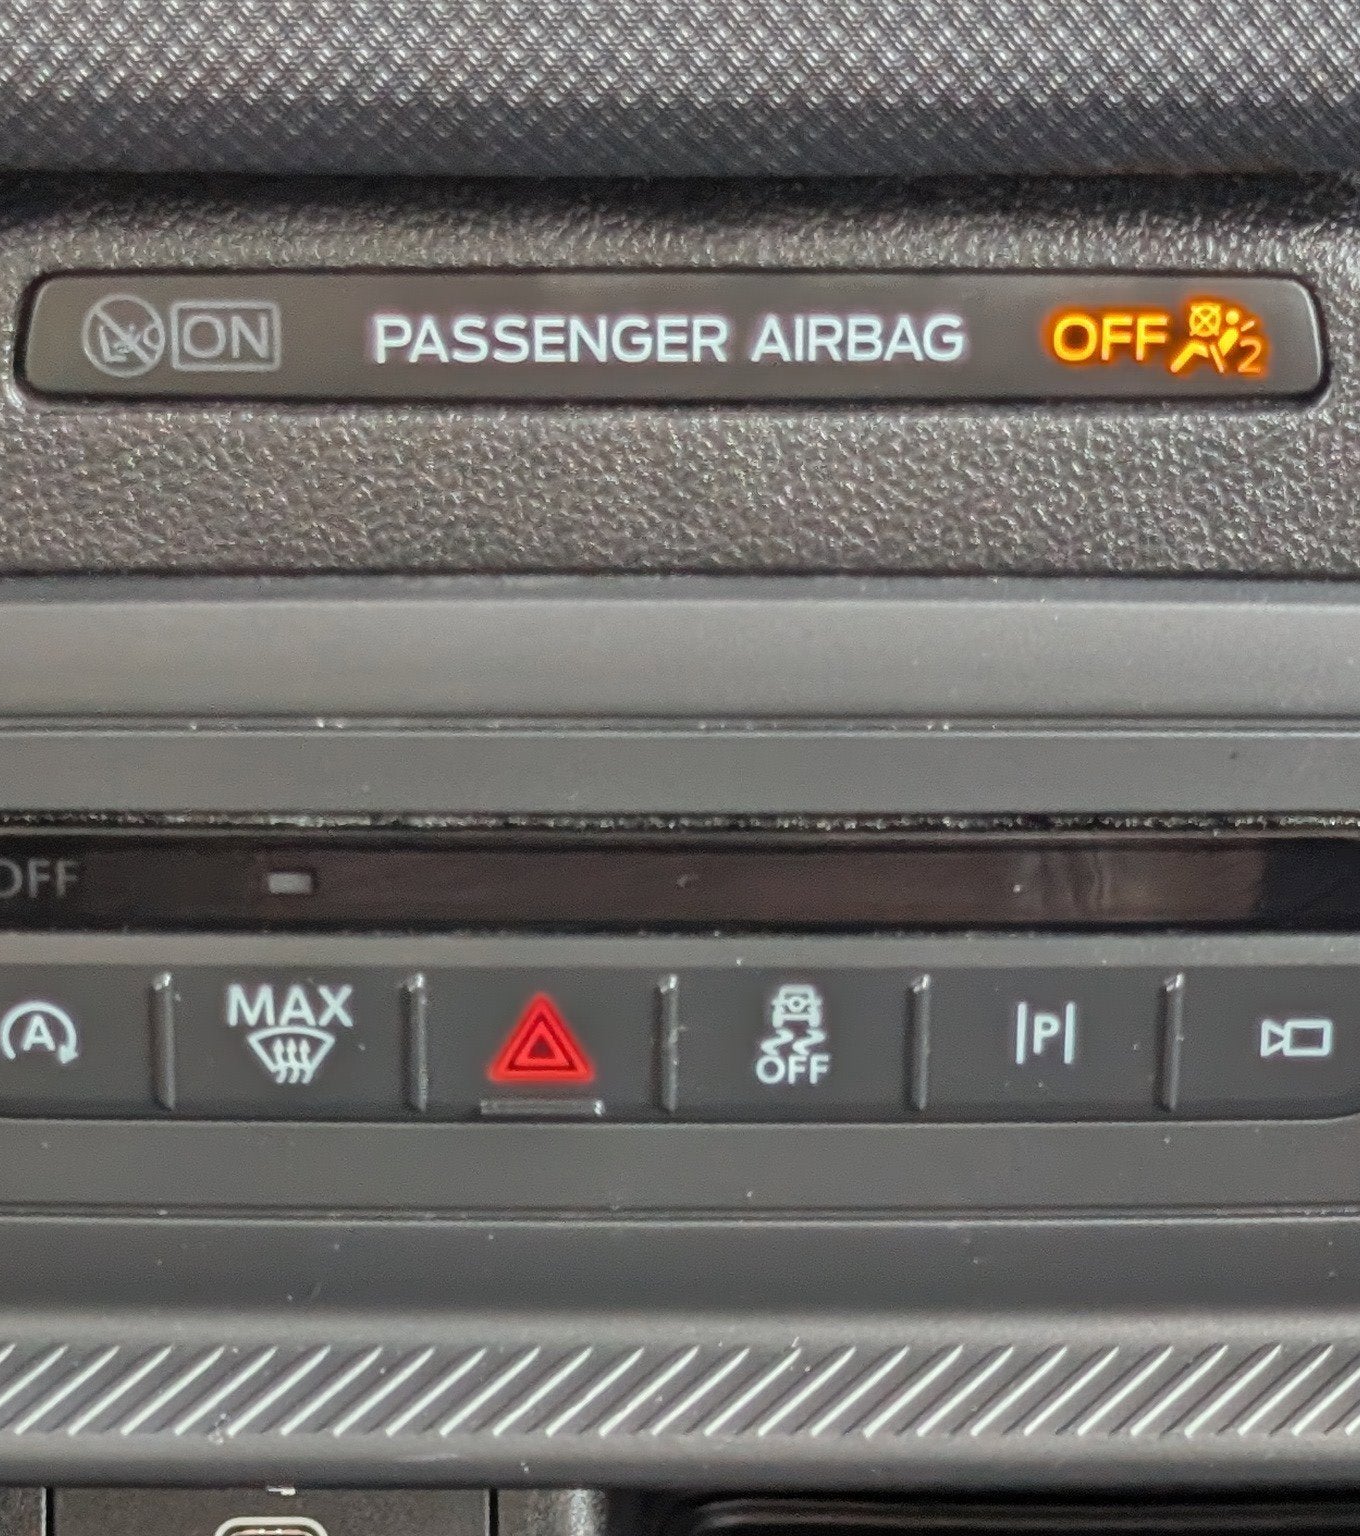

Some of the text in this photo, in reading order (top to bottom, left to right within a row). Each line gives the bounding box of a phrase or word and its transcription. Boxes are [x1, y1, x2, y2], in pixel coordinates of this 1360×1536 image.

[181, 313, 270, 359] ON
[371, 313, 966, 364] PASSENGER AIRBAG
[1052, 313, 1170, 363] OFF
[226, 984, 355, 1027] MAX
[755, 1055, 830, 1085] OFF
